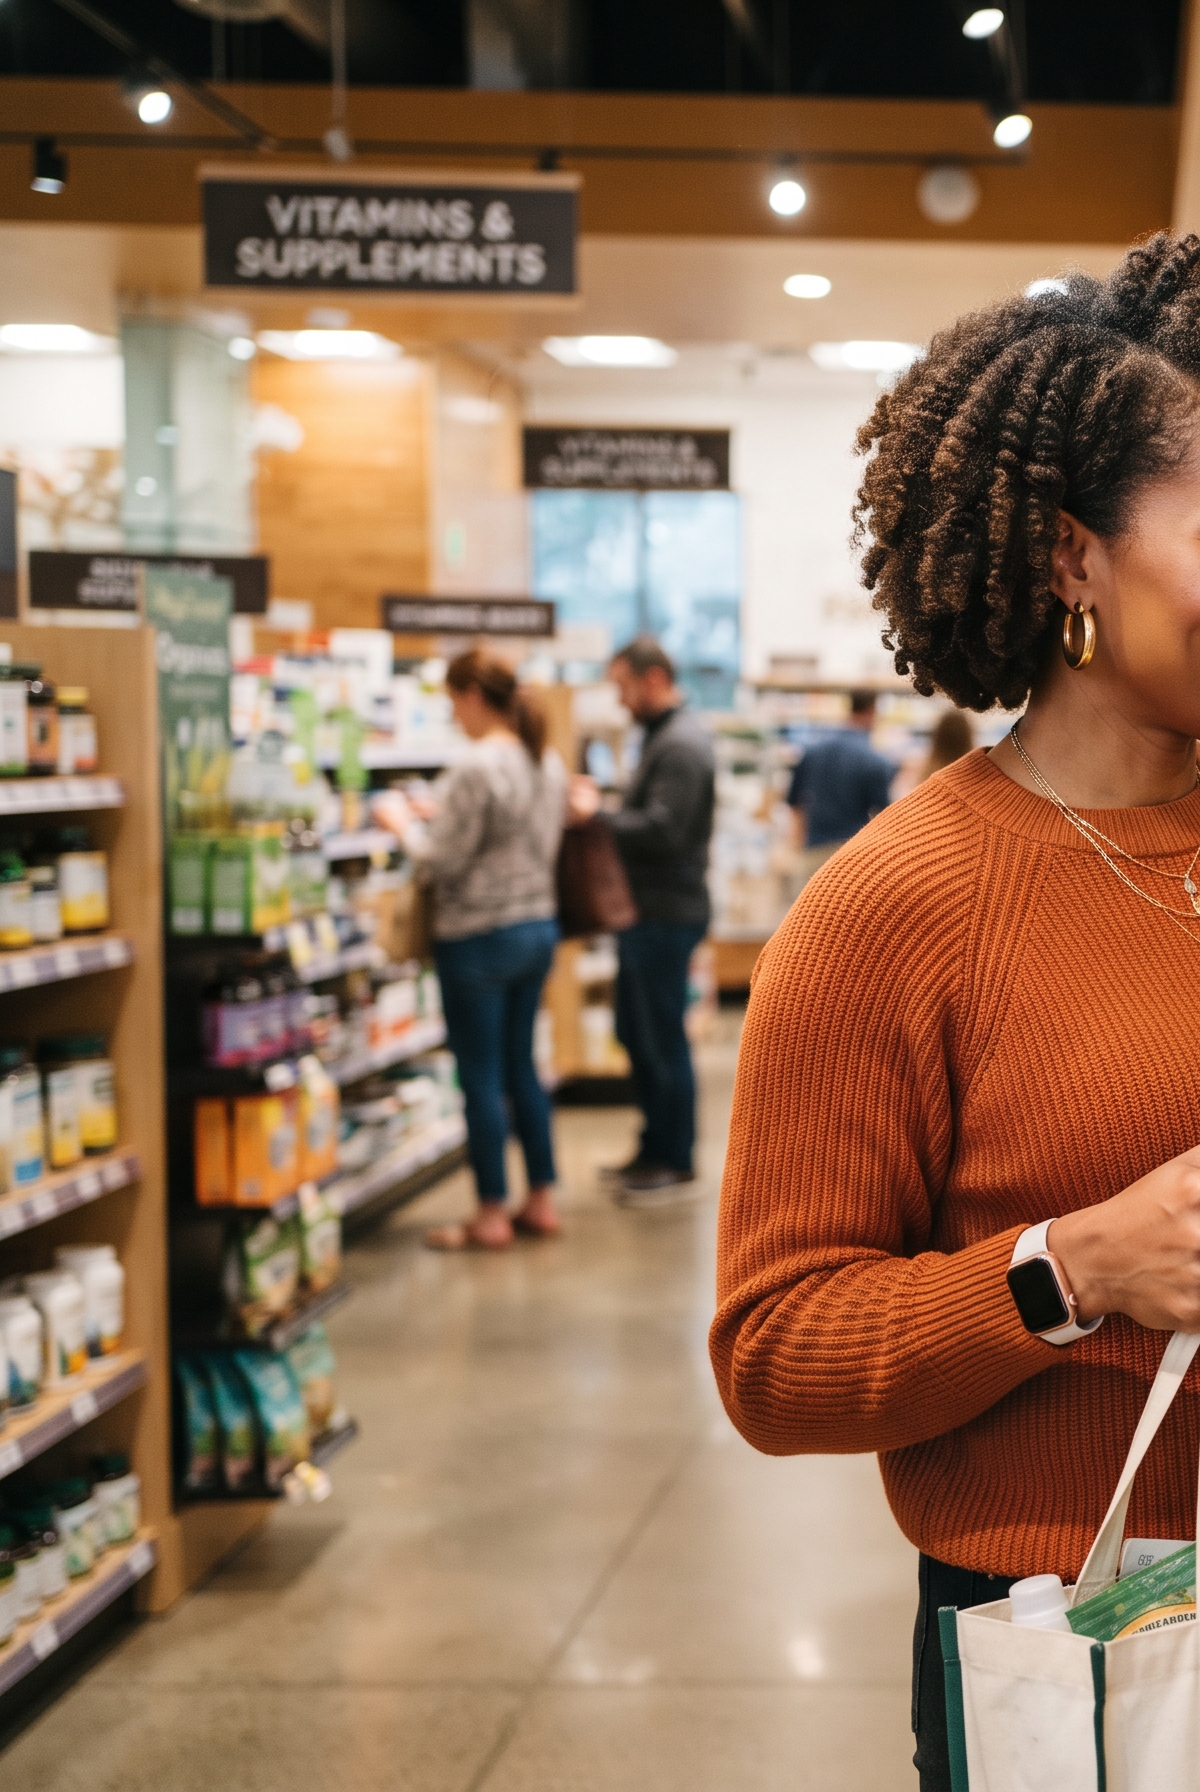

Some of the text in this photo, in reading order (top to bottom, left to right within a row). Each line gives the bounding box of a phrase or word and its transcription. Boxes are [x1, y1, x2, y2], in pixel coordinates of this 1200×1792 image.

[265, 195, 514, 241] VITAMINS &
[236, 236, 547, 285] SUPPLEMENTS
